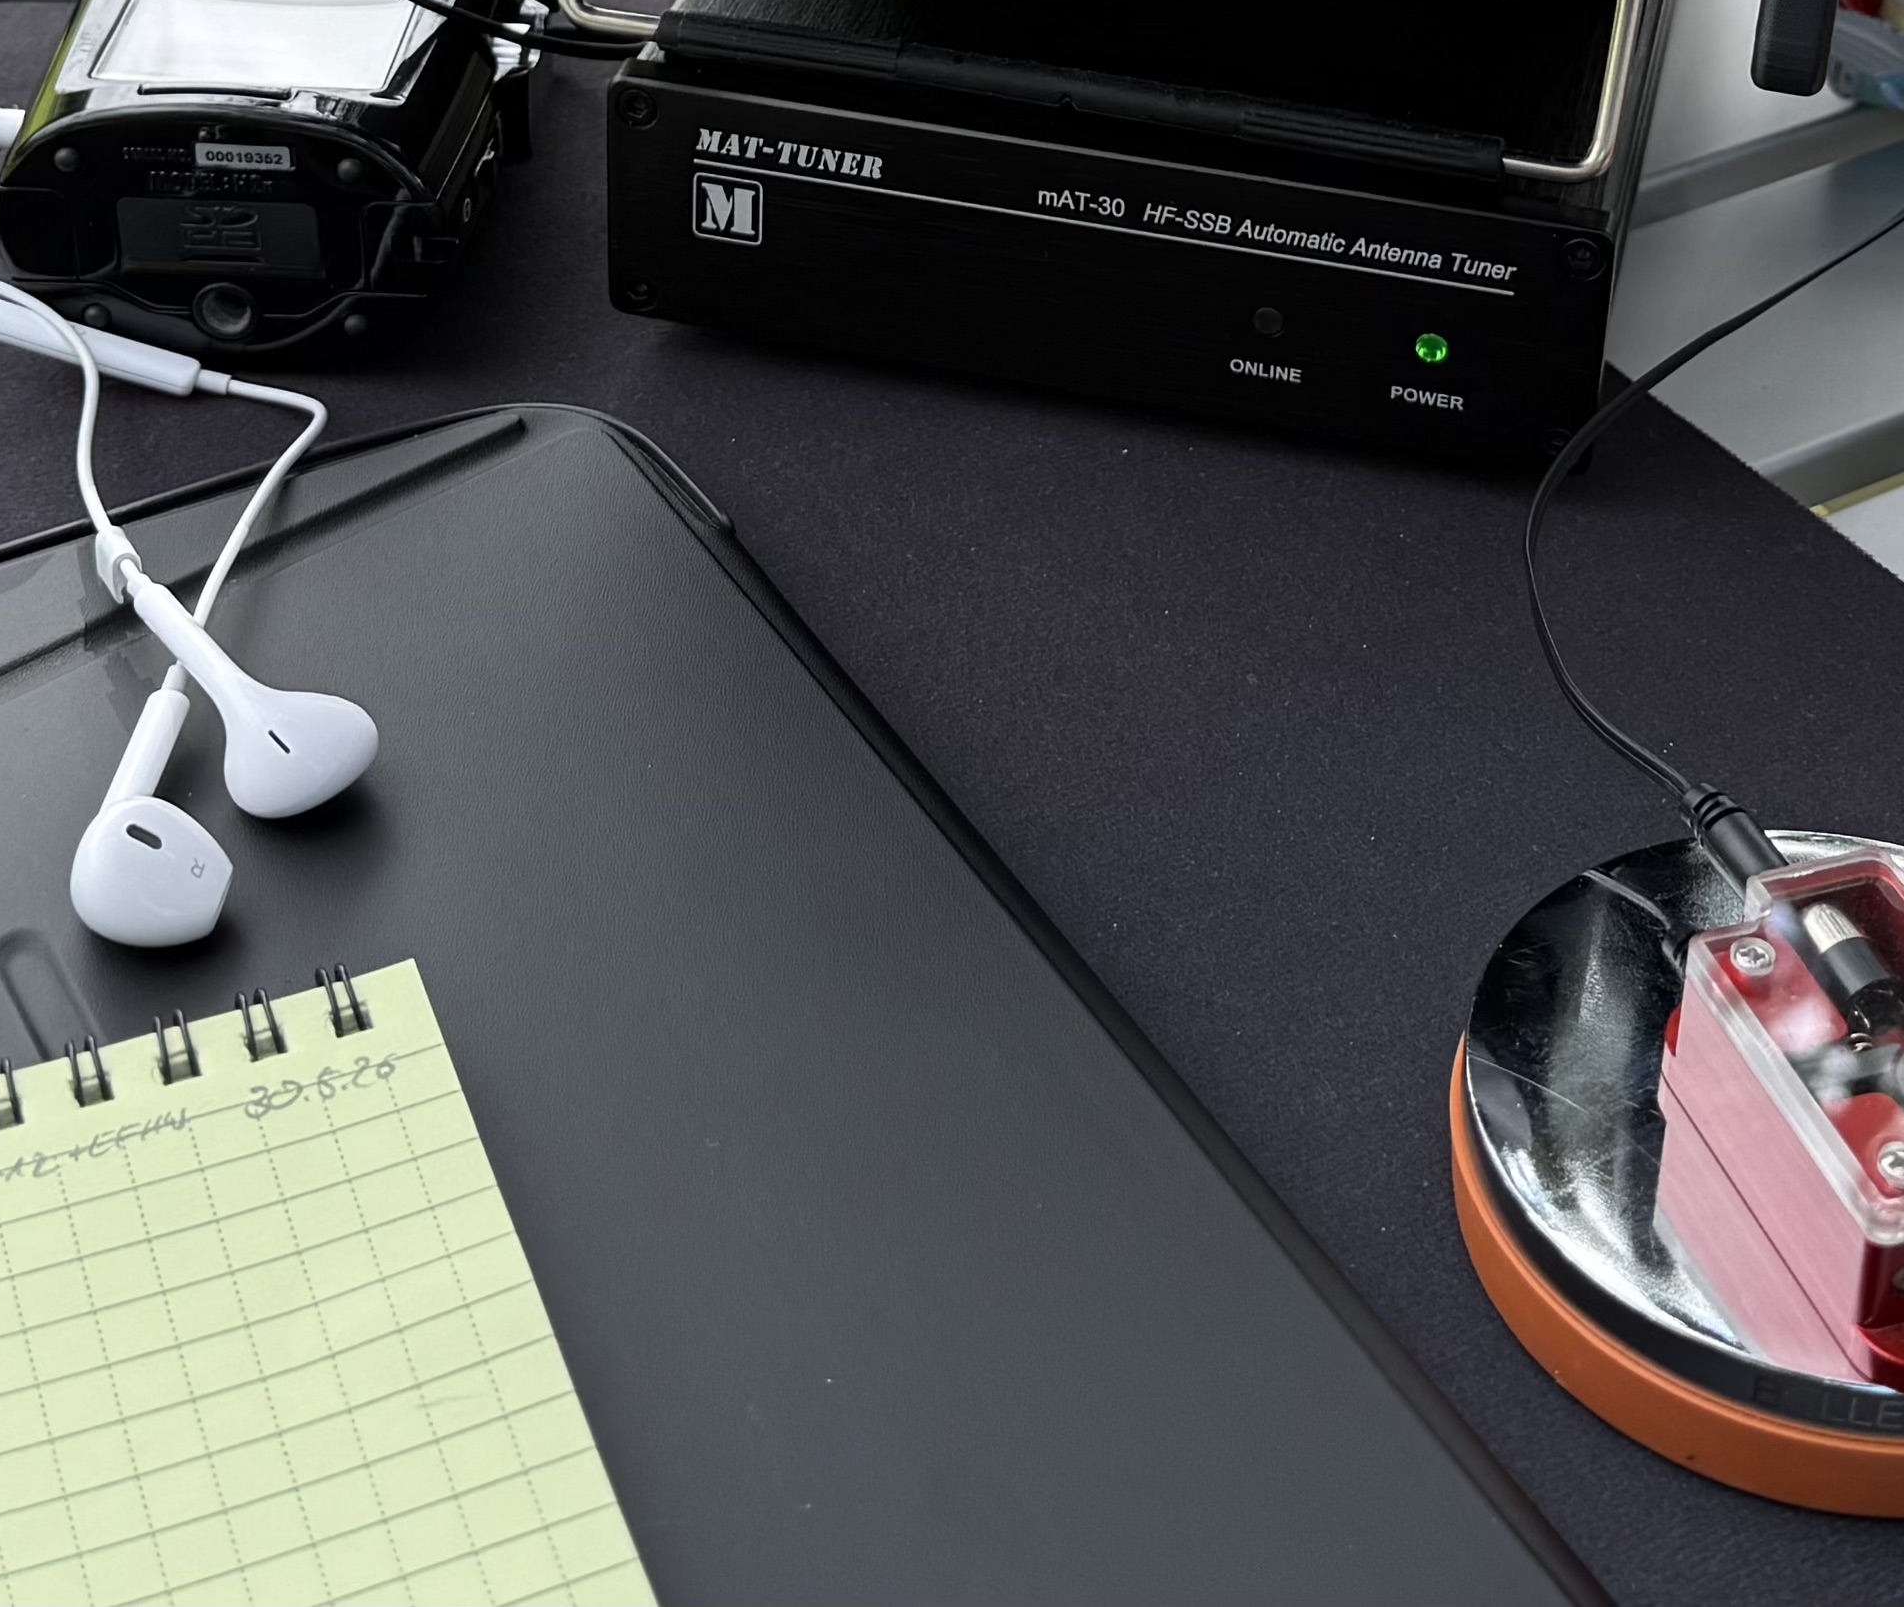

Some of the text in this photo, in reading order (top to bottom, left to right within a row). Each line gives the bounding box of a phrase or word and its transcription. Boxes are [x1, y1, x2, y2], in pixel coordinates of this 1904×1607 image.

[695, 127, 884, 180] MAT-TUNER
[700, 181, 757, 236] M
[1037, 189, 1518, 281] mAT-30 HF-SSB Automatic Antenna Tuner
[1228, 357, 1303, 384] ONLINE
[1389, 385, 1465, 412] POWER
[190, 857, 207, 879] R
